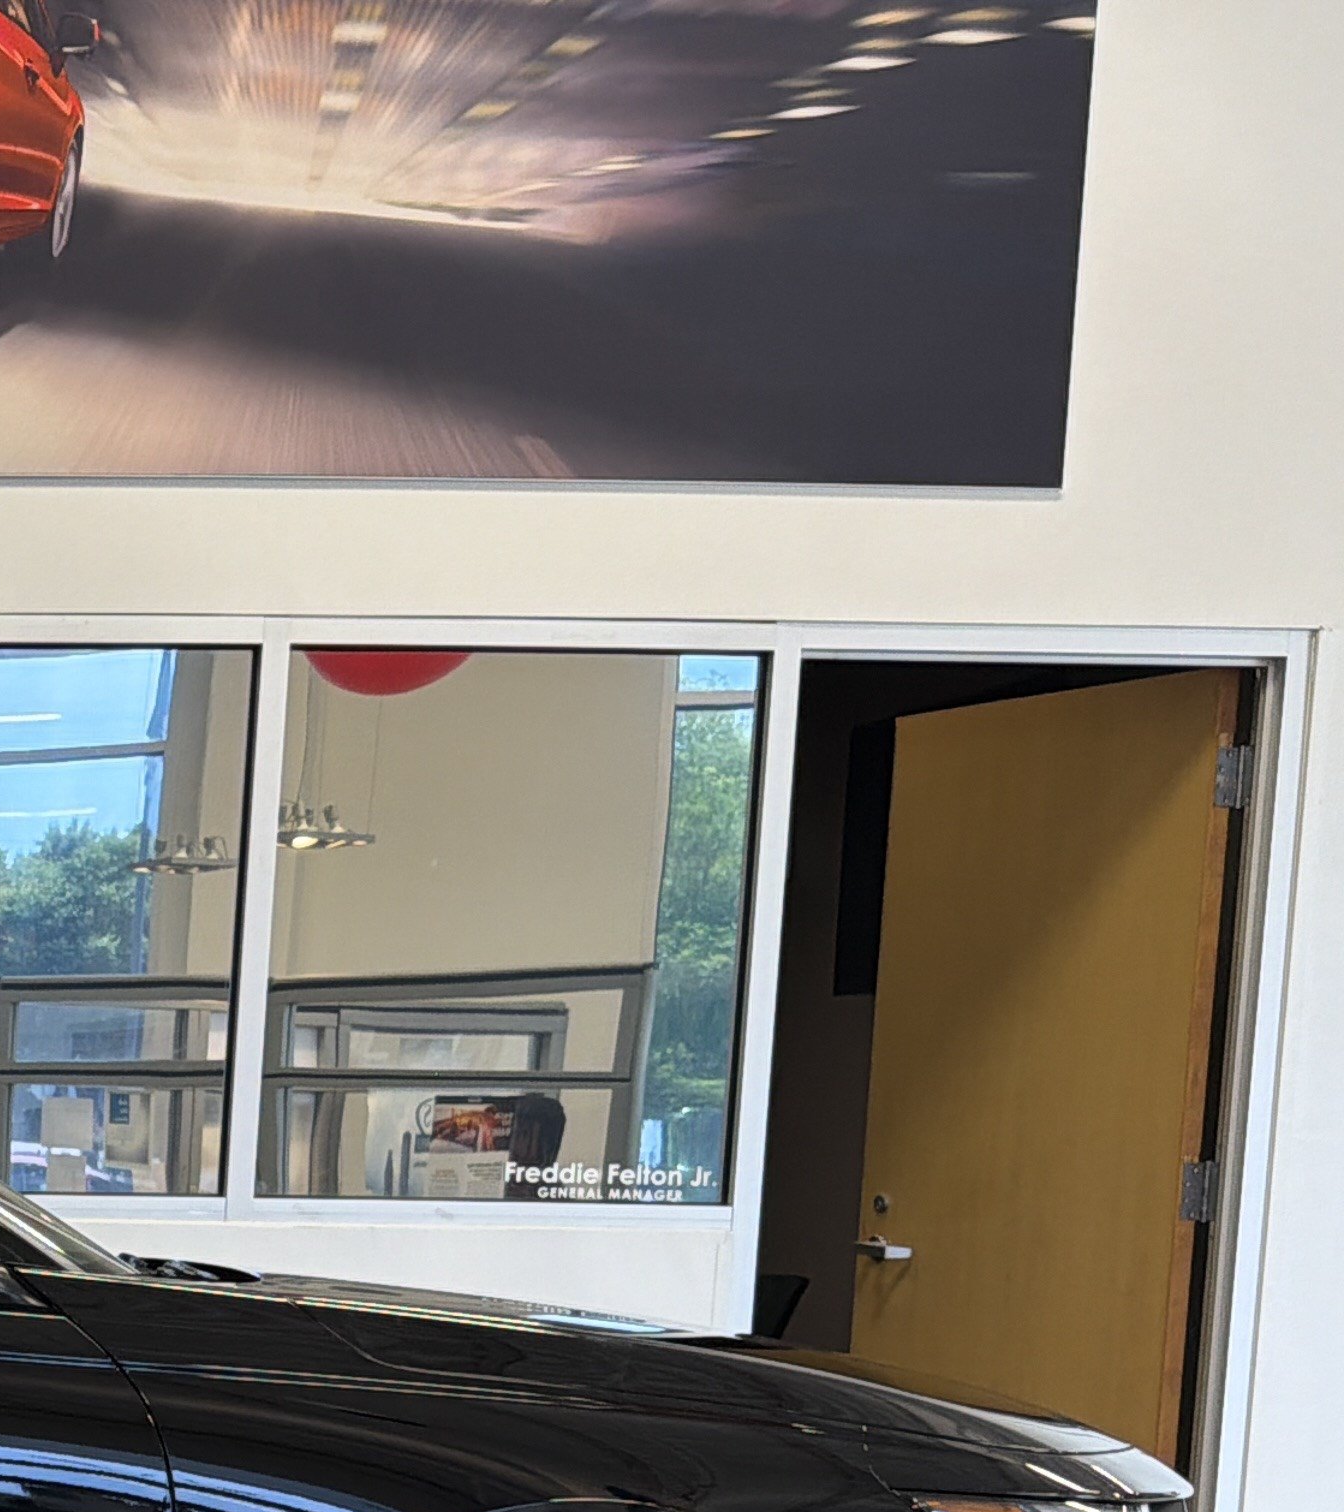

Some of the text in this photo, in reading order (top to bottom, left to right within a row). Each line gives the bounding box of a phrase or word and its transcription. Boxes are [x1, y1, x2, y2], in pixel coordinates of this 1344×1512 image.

[505, 1162, 598, 1184] Freddie
[607, 1162, 683, 1186] Felton
[689, 1164, 718, 1187] Jr.
[537, 1186, 683, 1202] GENERAL MANAGER
